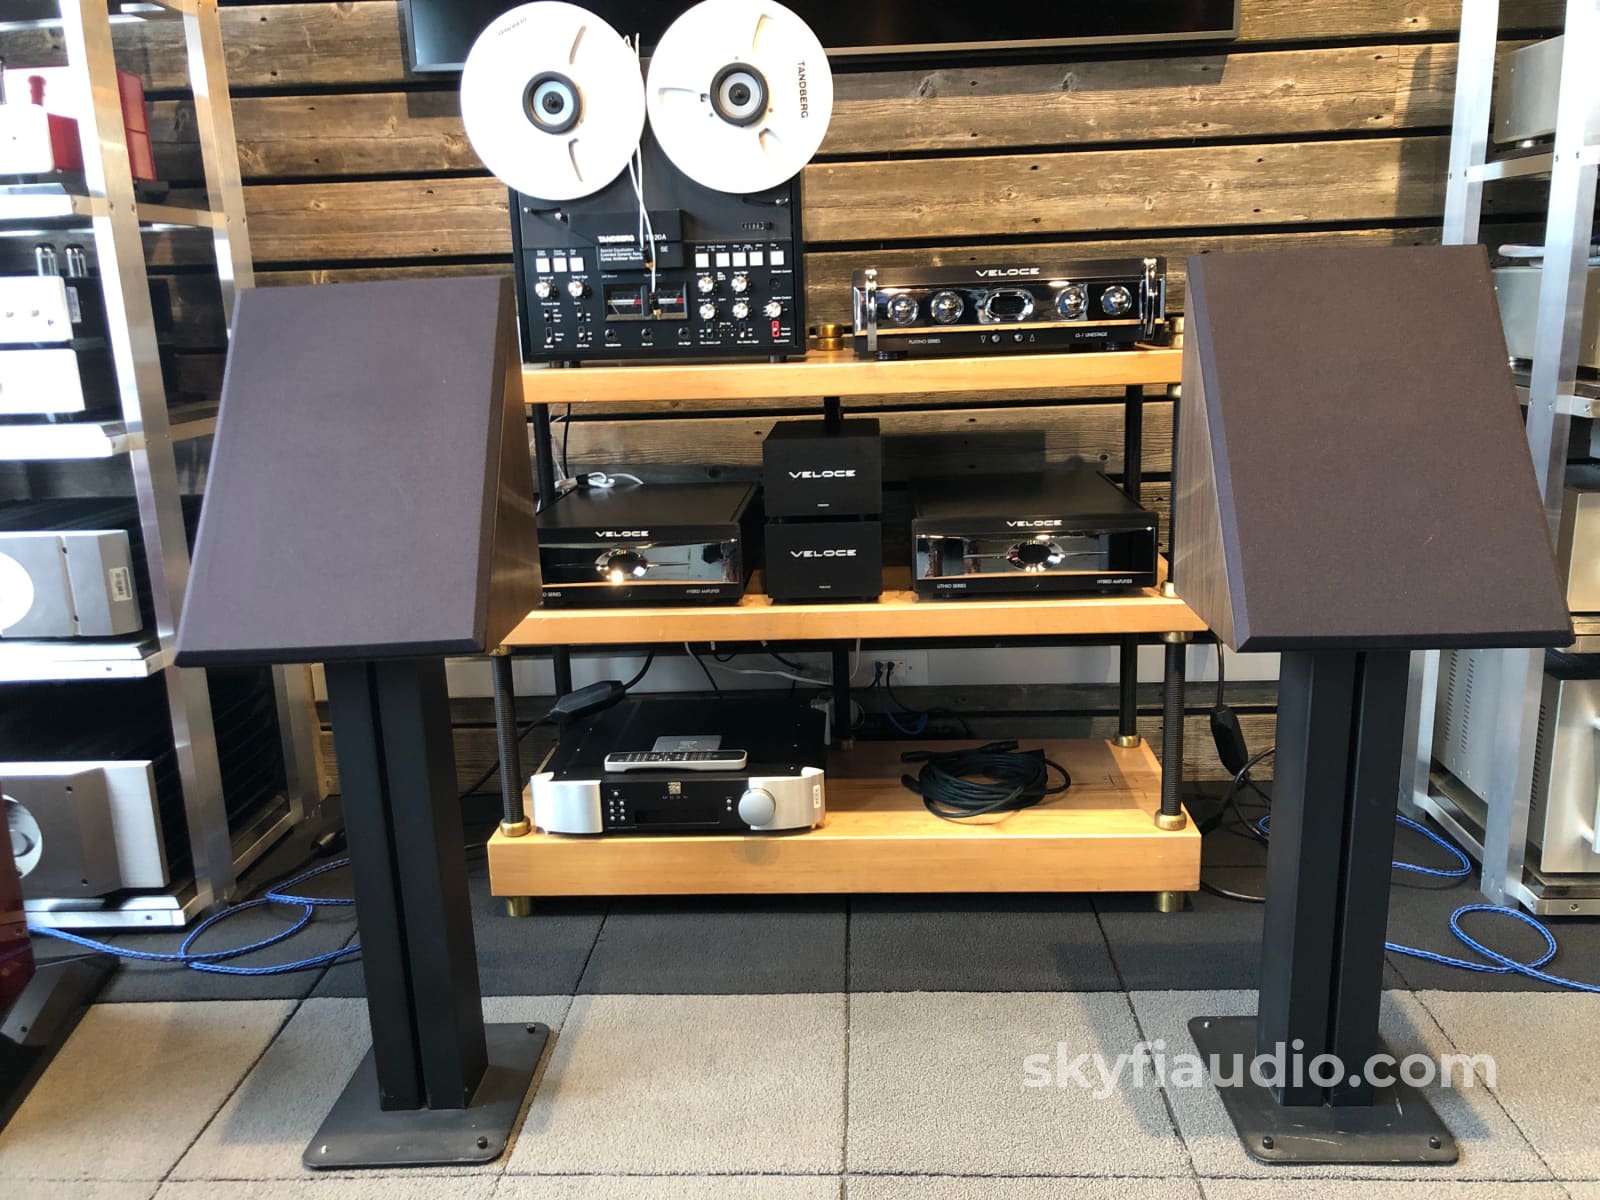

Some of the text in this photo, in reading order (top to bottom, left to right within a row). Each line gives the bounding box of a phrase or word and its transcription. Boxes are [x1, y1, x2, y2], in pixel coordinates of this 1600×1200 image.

[797, 61, 810, 119] TANDBERG
[976, 267, 1039, 277] VELOCE
[789, 469, 855, 480] VELOCE
[1007, 519, 1062, 527] VELOCE
[595, 530, 649, 538] VELOCE
[791, 549, 856, 559] VELOCE
